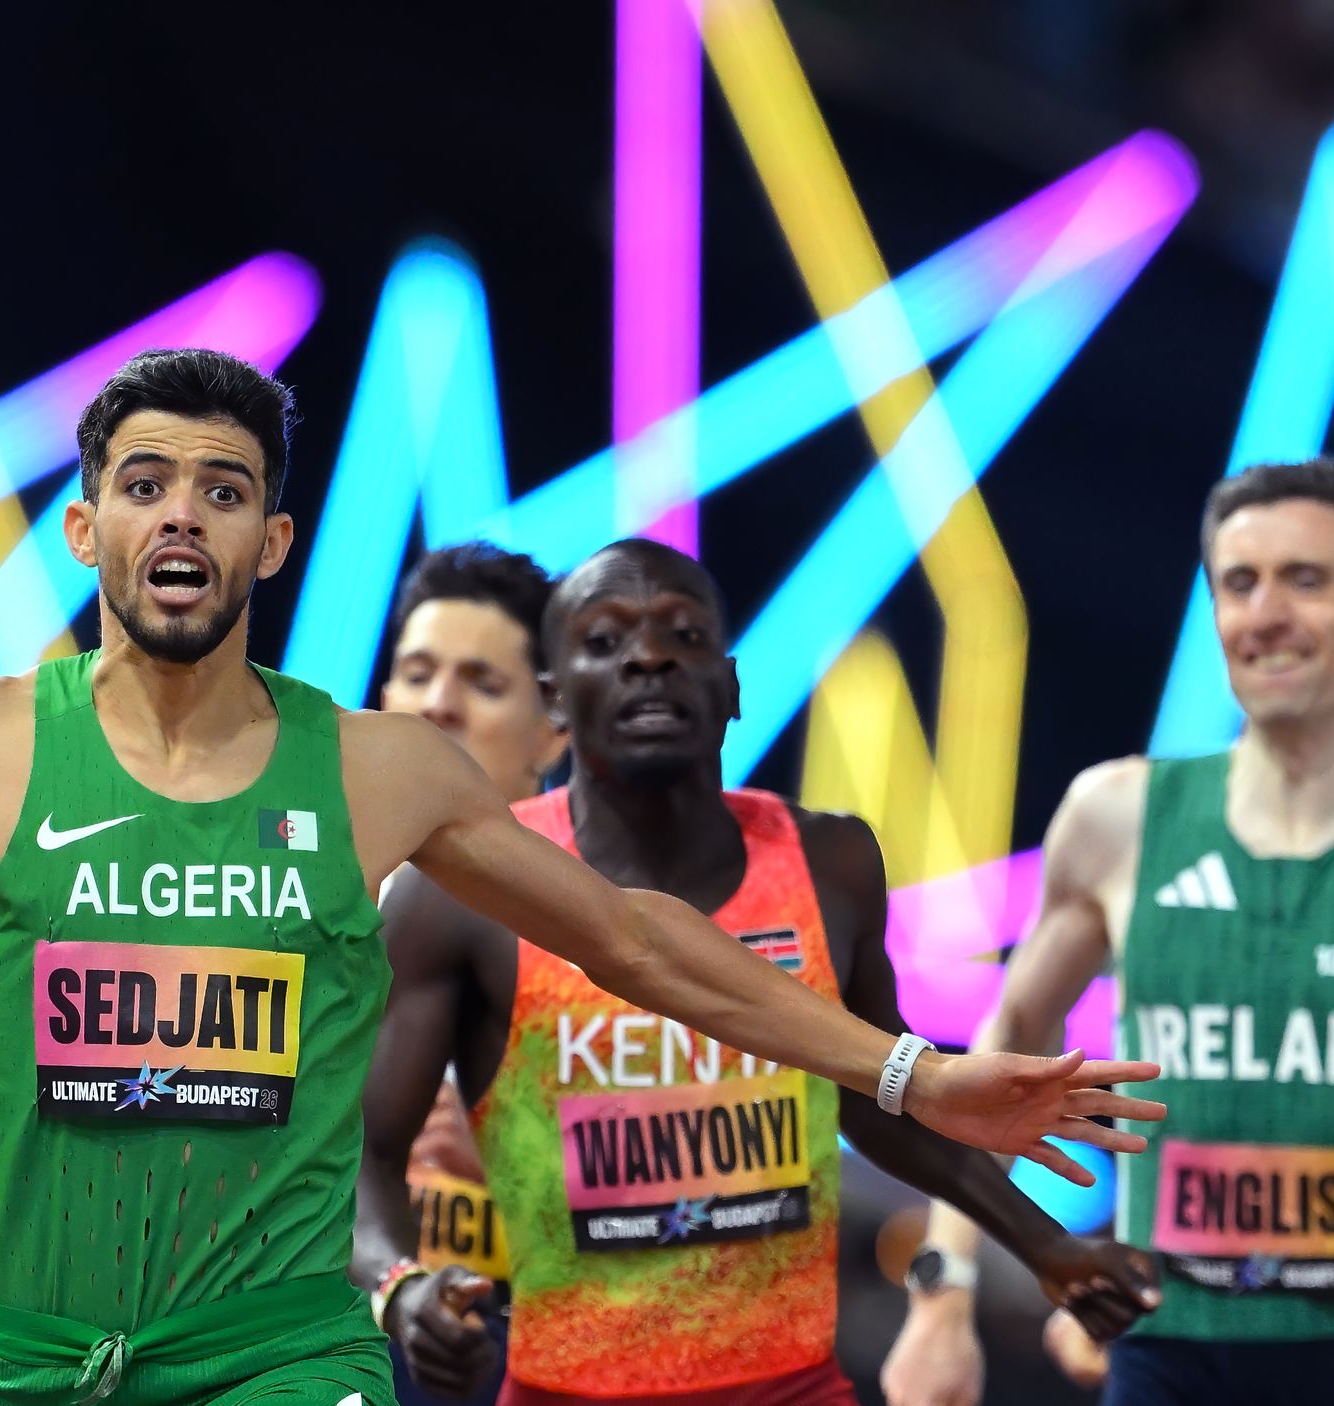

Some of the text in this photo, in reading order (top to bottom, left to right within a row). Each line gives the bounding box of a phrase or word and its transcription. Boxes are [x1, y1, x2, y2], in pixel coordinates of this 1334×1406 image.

[65, 862, 312, 920] ALGERIA
[46, 967, 289, 1055] SEDJATI
[556, 1013, 778, 1087] KEN
[51, 1080, 118, 1103] ULTIMATE
[175, 1083, 260, 1107] BUDAPEST
[571, 1096, 800, 1191] WANYONYI
[421, 1188, 493, 1260] ICI
